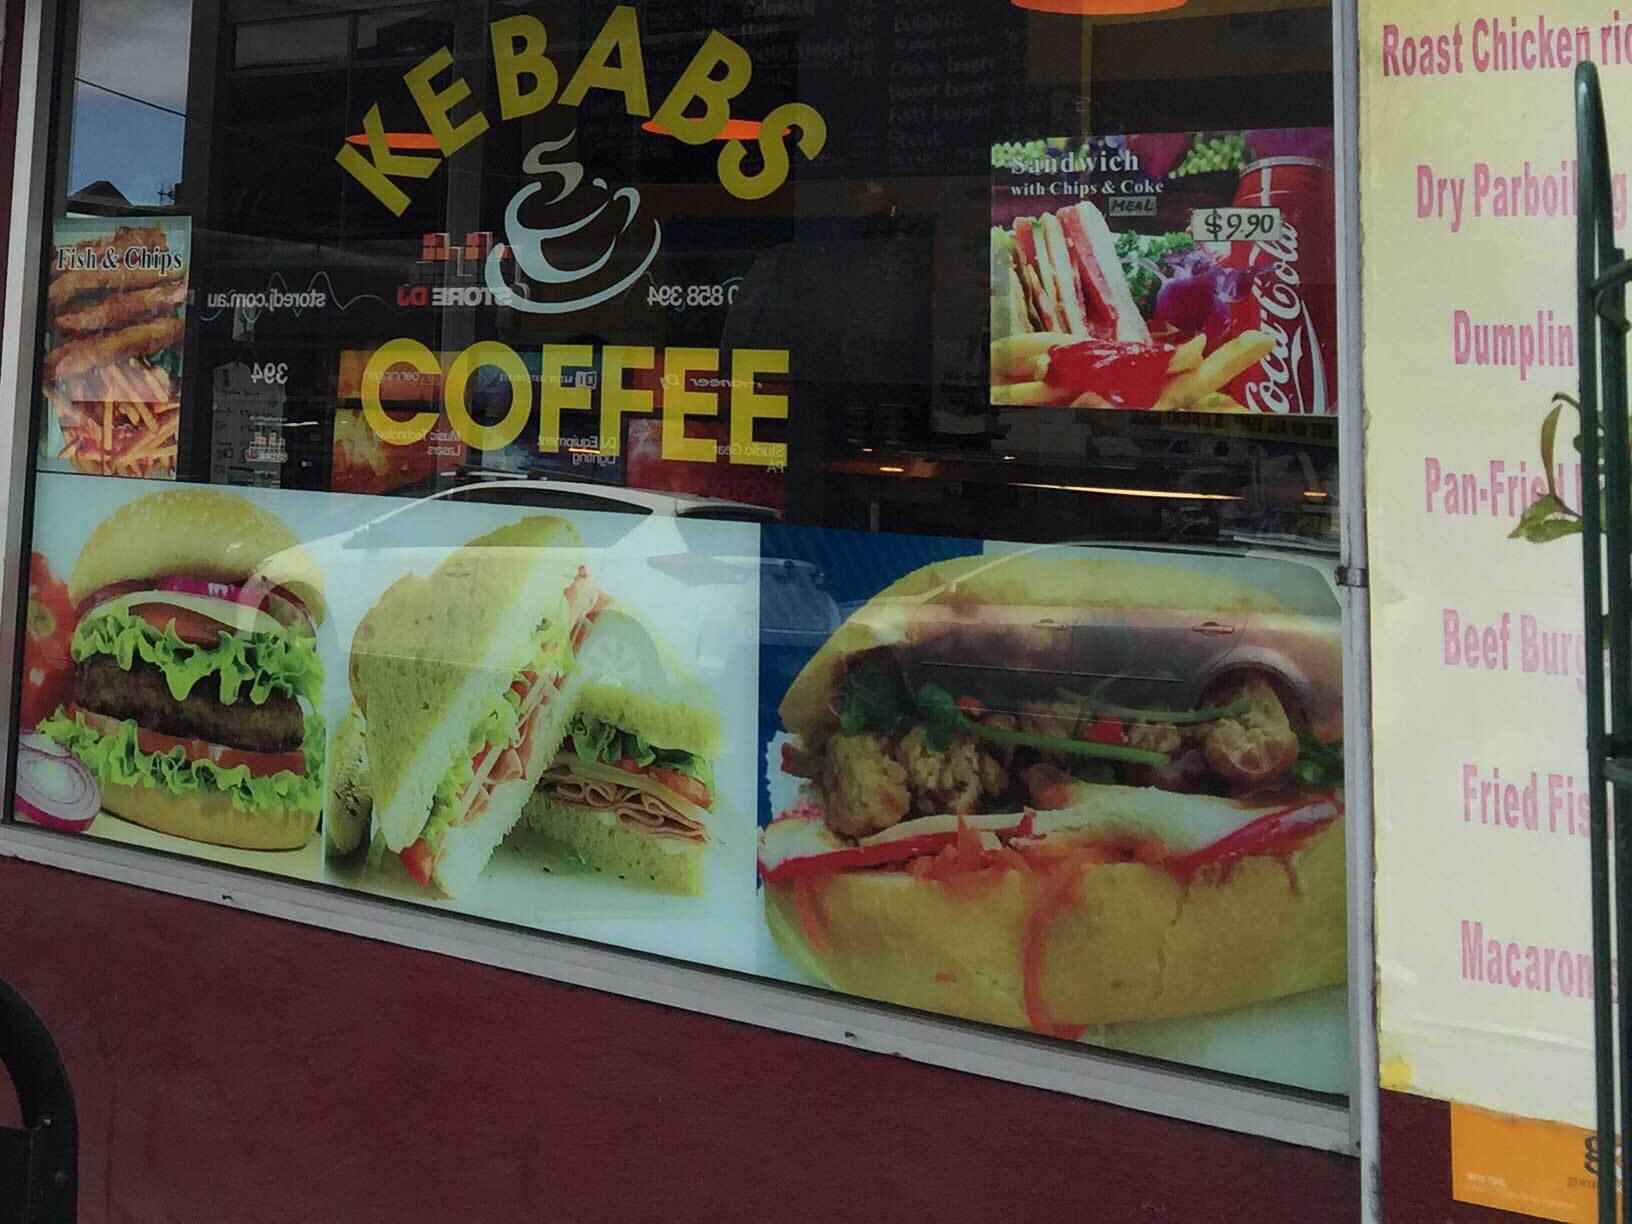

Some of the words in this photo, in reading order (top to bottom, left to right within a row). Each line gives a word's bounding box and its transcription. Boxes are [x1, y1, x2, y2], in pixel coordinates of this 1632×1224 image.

[1383, 22, 1464, 77] Roast
[1472, 15, 1591, 73] Chicken
[334, 5, 827, 218] KEBABS
[1010, 150, 1139, 175] Sandwich
[1010, 182, 1046, 196] with
[1049, 180, 1098, 198] Chips
[1101, 181, 1116, 195] &
[1120, 179, 1165, 194] Coke
[1417, 164, 1465, 232] Dry
[1474, 160, 1627, 231] Parboilg
[1110, 198, 1155, 213] MEAL
[1203, 209, 1275, 242] $9.90
[56, 247, 96, 270] Fish
[102, 248, 118, 270] &
[124, 246, 183, 274] Chips
[1454, 310, 1574, 381] Dumplin
[361, 338, 789, 467] COFFEE
[1443, 608, 1510, 671] Beef
[1520, 614, 1587, 696] Burg
[1463, 763, 1539, 831] Fried
[1548, 774, 1613, 841] Fis
[1461, 920, 1618, 1004] Macaron
